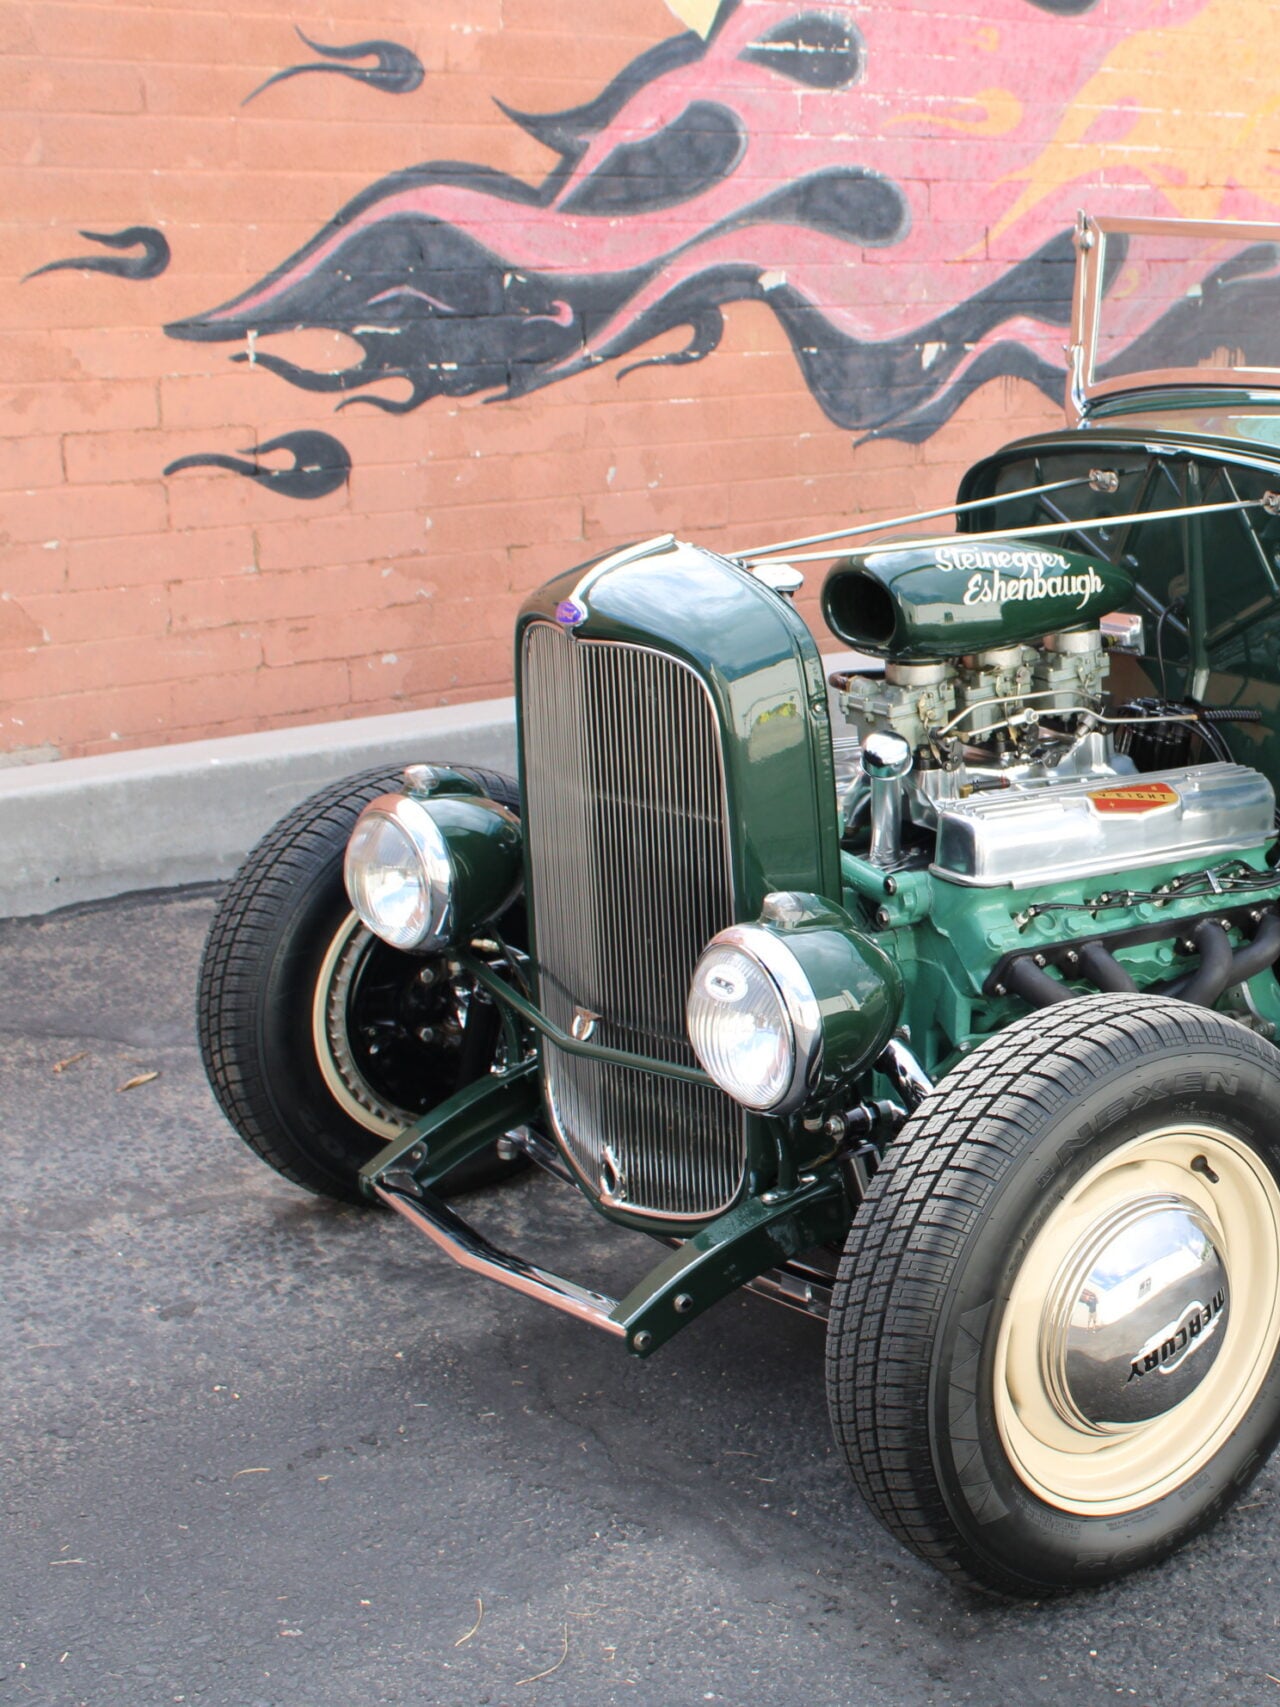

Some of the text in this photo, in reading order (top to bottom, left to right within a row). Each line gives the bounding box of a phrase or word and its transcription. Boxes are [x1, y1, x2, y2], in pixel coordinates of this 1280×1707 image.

[934, 546, 1072, 578] Steinegger
[962, 566, 1106, 611] Eshenbaugh
[1115, 792, 1167, 801] EIGHT
[1057, 1070, 1241, 1168] NEXEN
[1127, 1285, 1226, 1382] MERCURY
